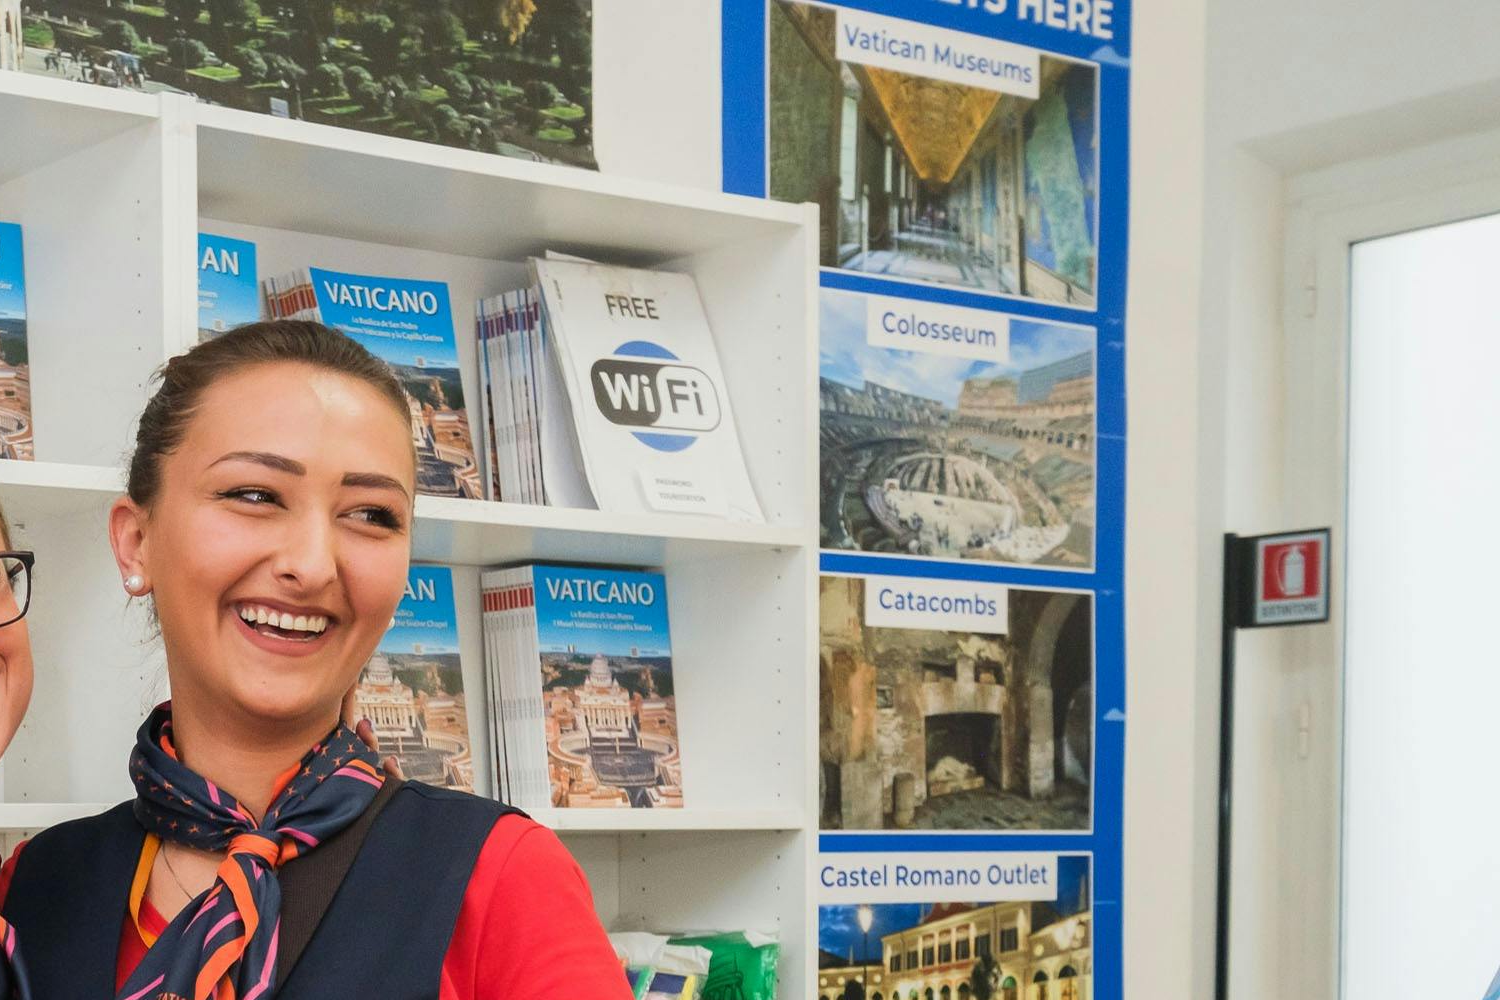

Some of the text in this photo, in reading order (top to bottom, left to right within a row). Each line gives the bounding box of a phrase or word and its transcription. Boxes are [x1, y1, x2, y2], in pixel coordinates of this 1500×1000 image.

[845, 25, 1032, 83] Vatican Museums
[324, 281, 438, 315] VATICANO
[604, 294, 660, 320] FREE
[882, 311, 996, 346] Colosseum
[546, 577, 654, 605] VATICANO
[879, 588, 997, 616] Catacombs
[820, 863, 1048, 887] Castel Romano Outlet
